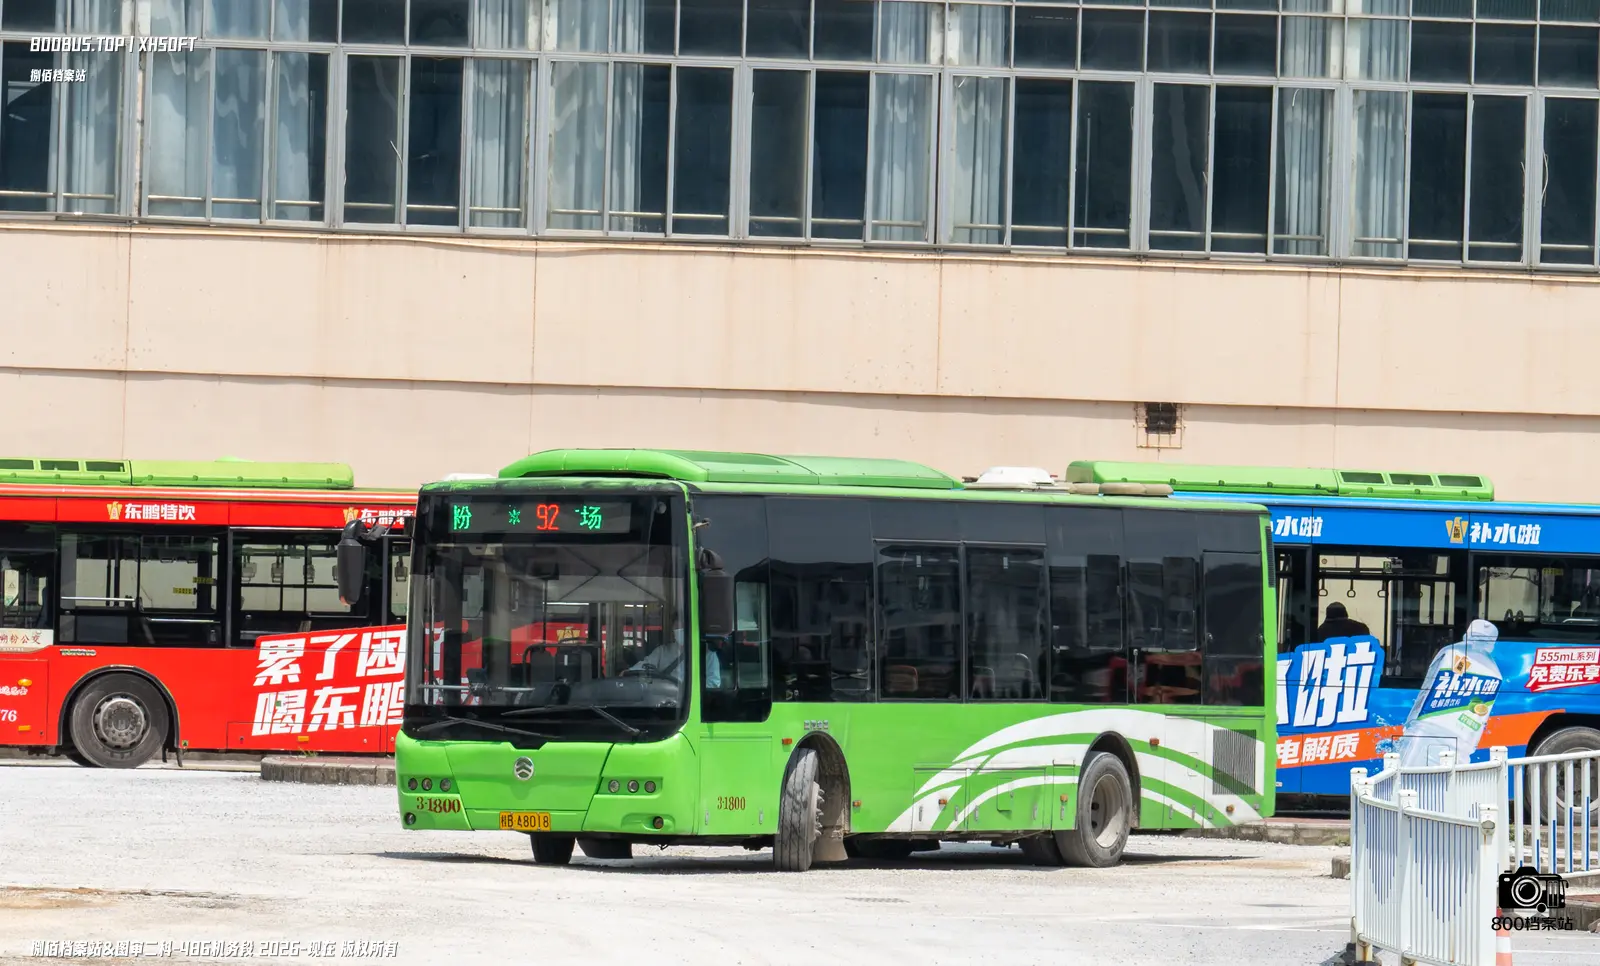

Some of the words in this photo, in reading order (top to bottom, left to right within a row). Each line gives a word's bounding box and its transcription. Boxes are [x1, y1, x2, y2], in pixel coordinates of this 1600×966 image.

[125, 503, 196, 520] 东鹏特饮
[361, 508, 417, 525] 东鹏特
[536, 504, 559, 530] 92
[578, 505, 601, 530] 场
[1270, 516, 1323, 537] 水啦
[1470, 522, 1541, 544] 补水啦
[1540, 651, 1597, 662] 555mL系列
[1434, 672, 1500, 698] 补水啦
[1526, 665, 1600, 687] 免费乐享
[1276, 732, 1360, 765] 电解质
[416, 796, 461, 813] 3-1800
[717, 796, 746, 811] 3-1800
